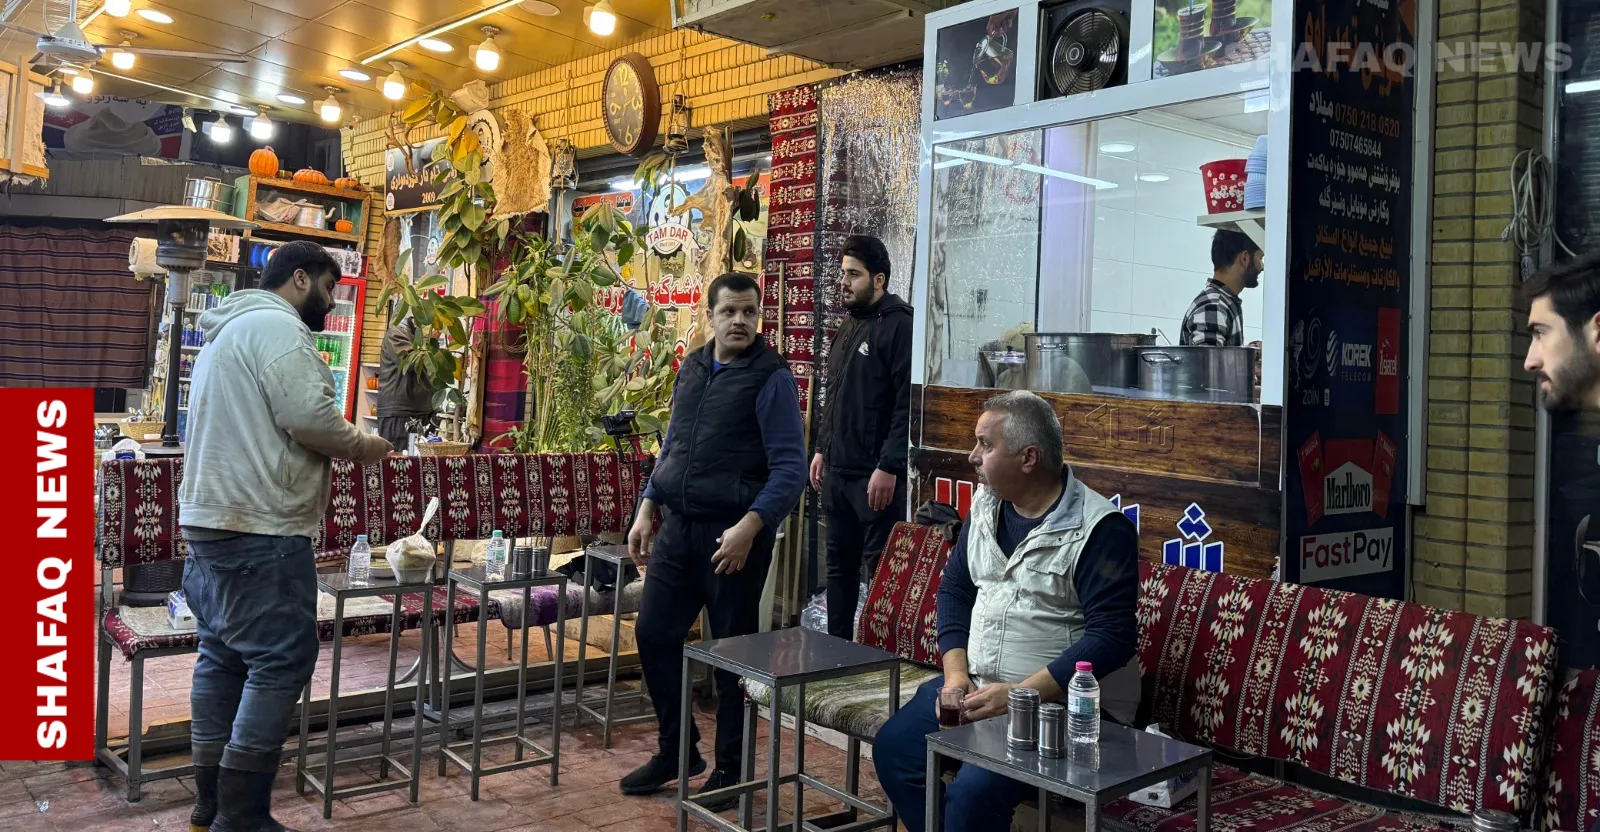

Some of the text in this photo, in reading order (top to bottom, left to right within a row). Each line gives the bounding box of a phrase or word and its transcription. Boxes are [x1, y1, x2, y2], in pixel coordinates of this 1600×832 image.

[1335, 102, 1358, 127] 0750
[1360, 110, 1376, 133] 218
[1379, 115, 1400, 138] 0520
[1330, 128, 1382, 159] 07507465844
[422, 191, 436, 204] 2009
[648, 226, 688, 244] TAM DAR
[1341, 342, 1373, 368] KOREK
[1341, 371, 1372, 382] TELECOM
[1326, 472, 1371, 510] Marlboro
[1302, 532, 1392, 570] FastPay
